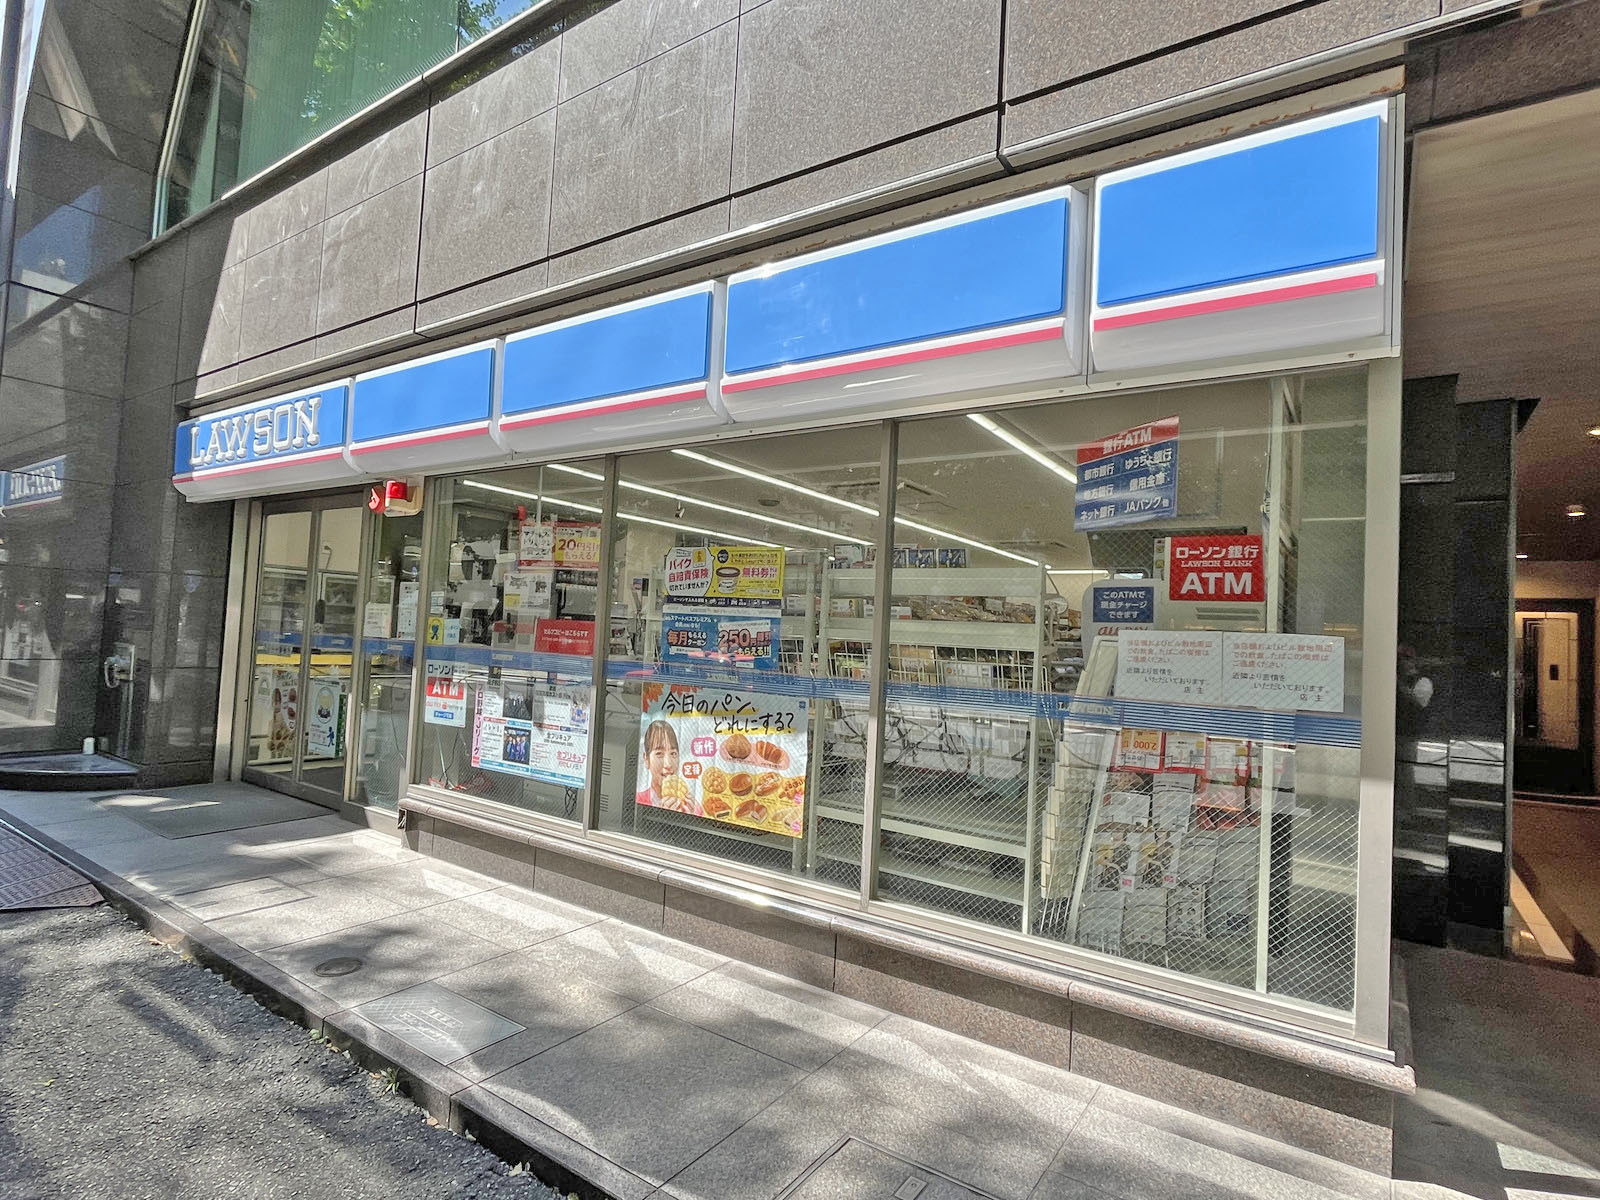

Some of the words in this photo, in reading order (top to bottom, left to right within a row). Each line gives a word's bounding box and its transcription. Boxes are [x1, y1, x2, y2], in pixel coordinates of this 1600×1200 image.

[189, 397, 321, 467] LAWSON
[1175, 545, 1259, 559] ローソン銀行
[669, 558, 692, 571] バイク
[1224, 560, 1253, 568] BANK
[1180, 572, 1253, 595] ATM
[1102, 590, 1146, 599] このATMで
[1100, 600, 1148, 609] 現金チャージ
[1108, 610, 1140, 619] できます
[668, 630, 689, 646] 毎月
[432, 681, 460, 697] ATM
[661, 691, 756, 716] 今日のパン、
[713, 712, 795, 734] どれにする?
[693, 739, 715, 755] 新作
